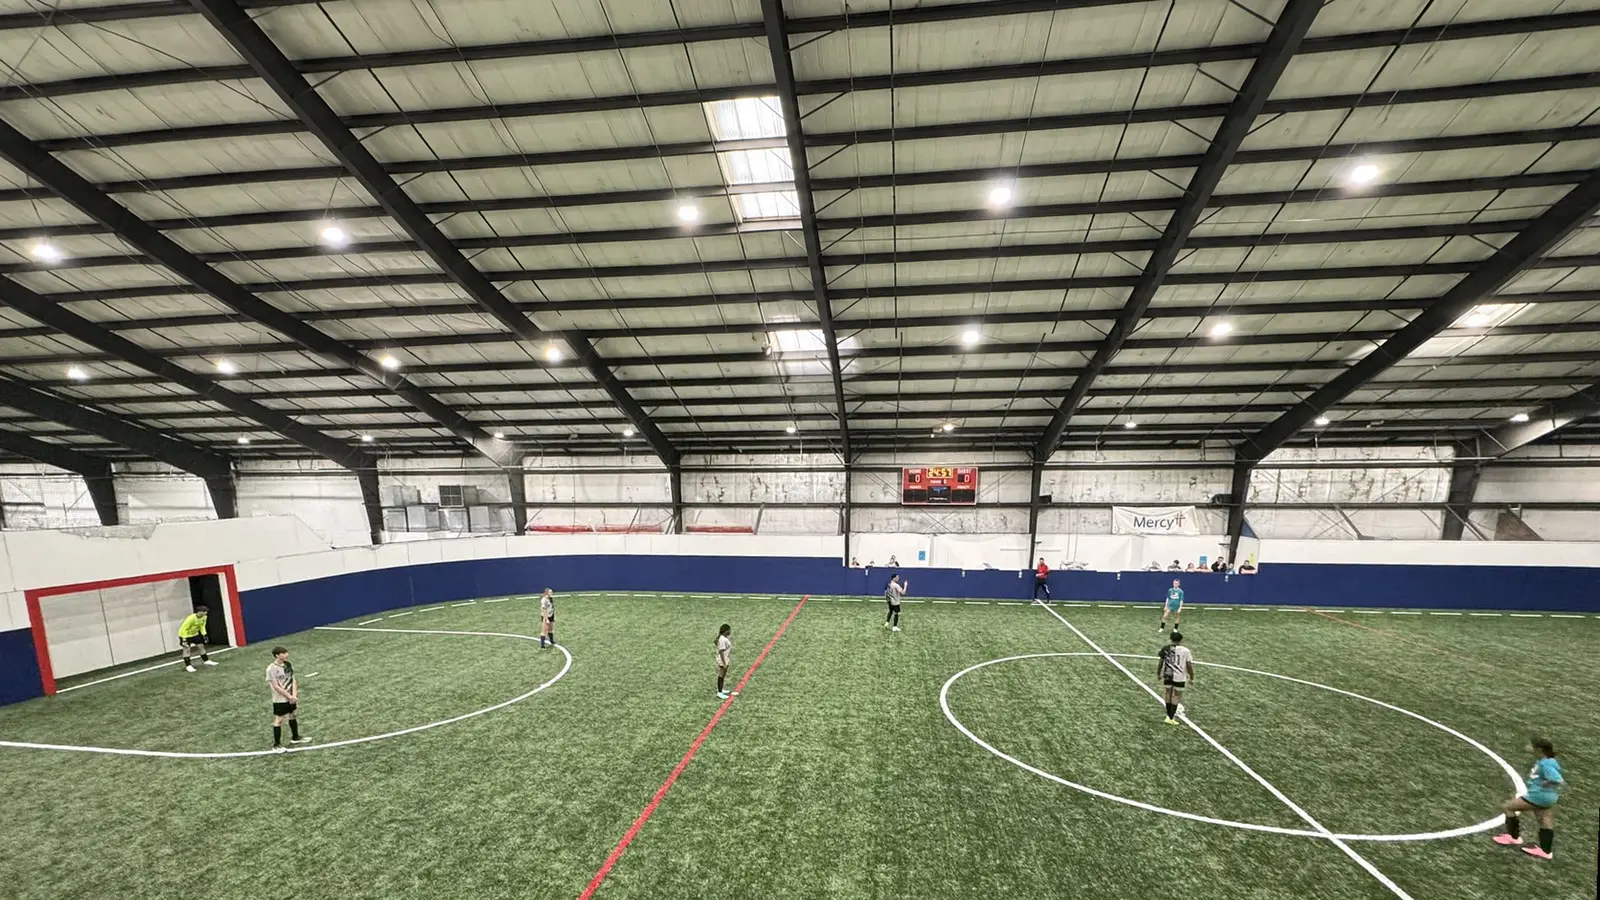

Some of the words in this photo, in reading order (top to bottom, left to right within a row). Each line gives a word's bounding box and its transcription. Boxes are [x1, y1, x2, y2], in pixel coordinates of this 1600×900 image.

[915, 474, 920, 483] 0
[964, 474, 970, 483] 0
[1133, 516, 1175, 530] Mercy
